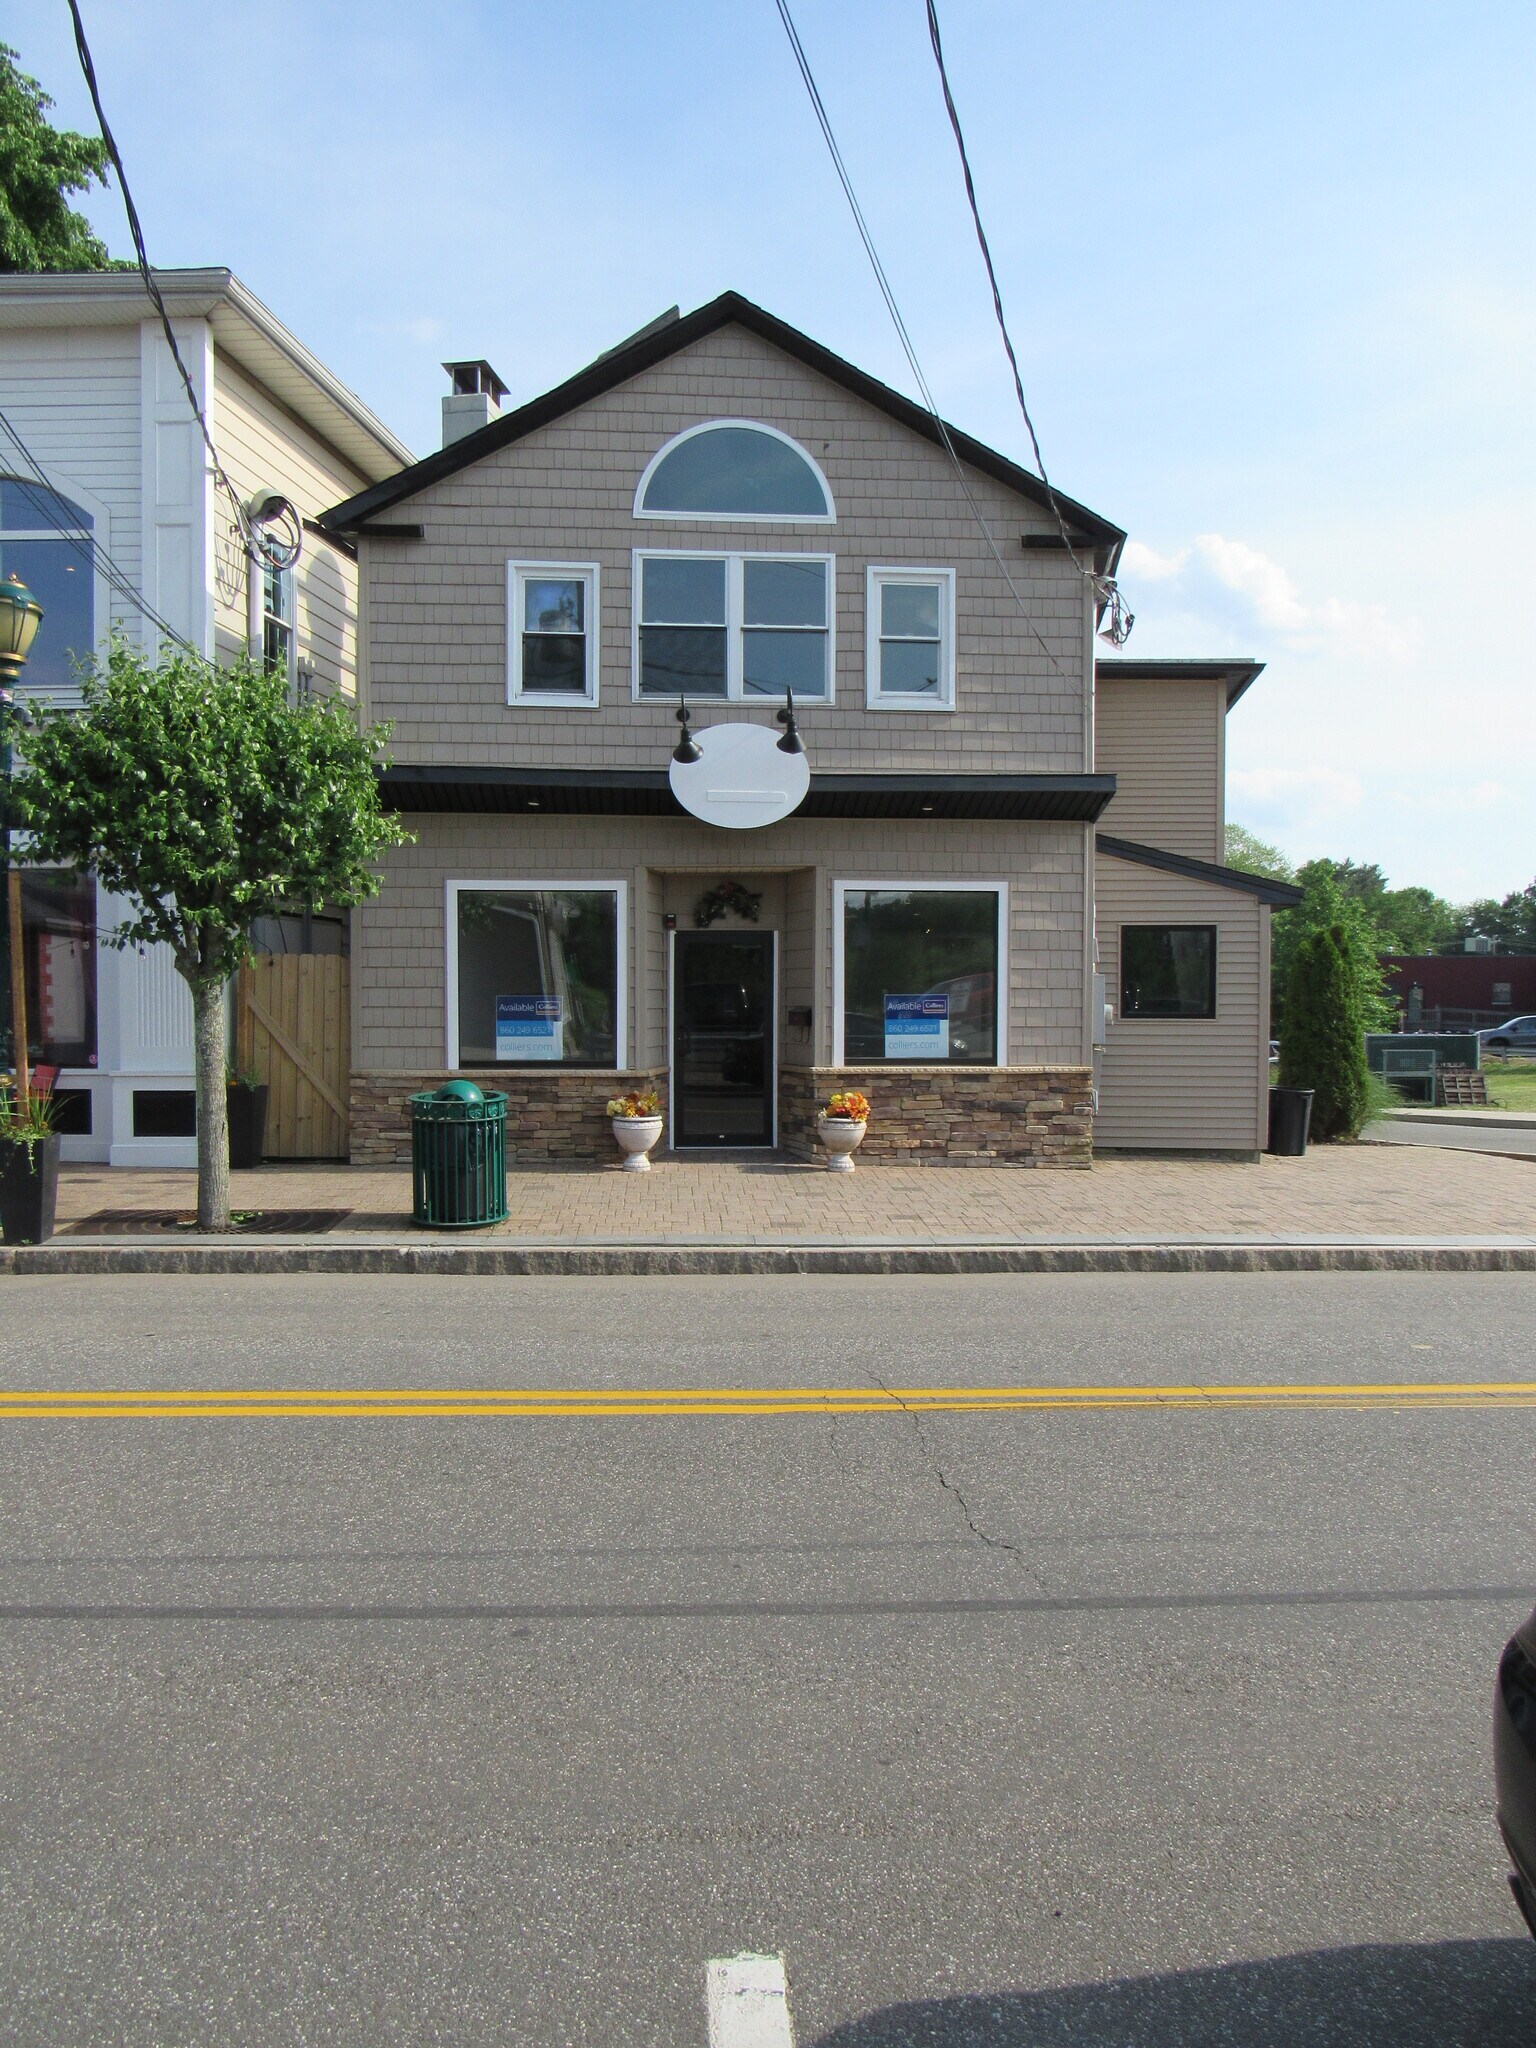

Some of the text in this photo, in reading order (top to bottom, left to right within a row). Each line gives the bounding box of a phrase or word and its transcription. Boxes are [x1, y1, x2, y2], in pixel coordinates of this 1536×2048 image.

[499, 1003, 535, 1012] Available
[888, 1002, 922, 1010] Available
[499, 1026, 551, 1034] 860 249 6521
[888, 1024, 937, 1033] 860 249 6521
[500, 1042, 553, 1051] colliers.com
[888, 1040, 939, 1049] colliers.com
